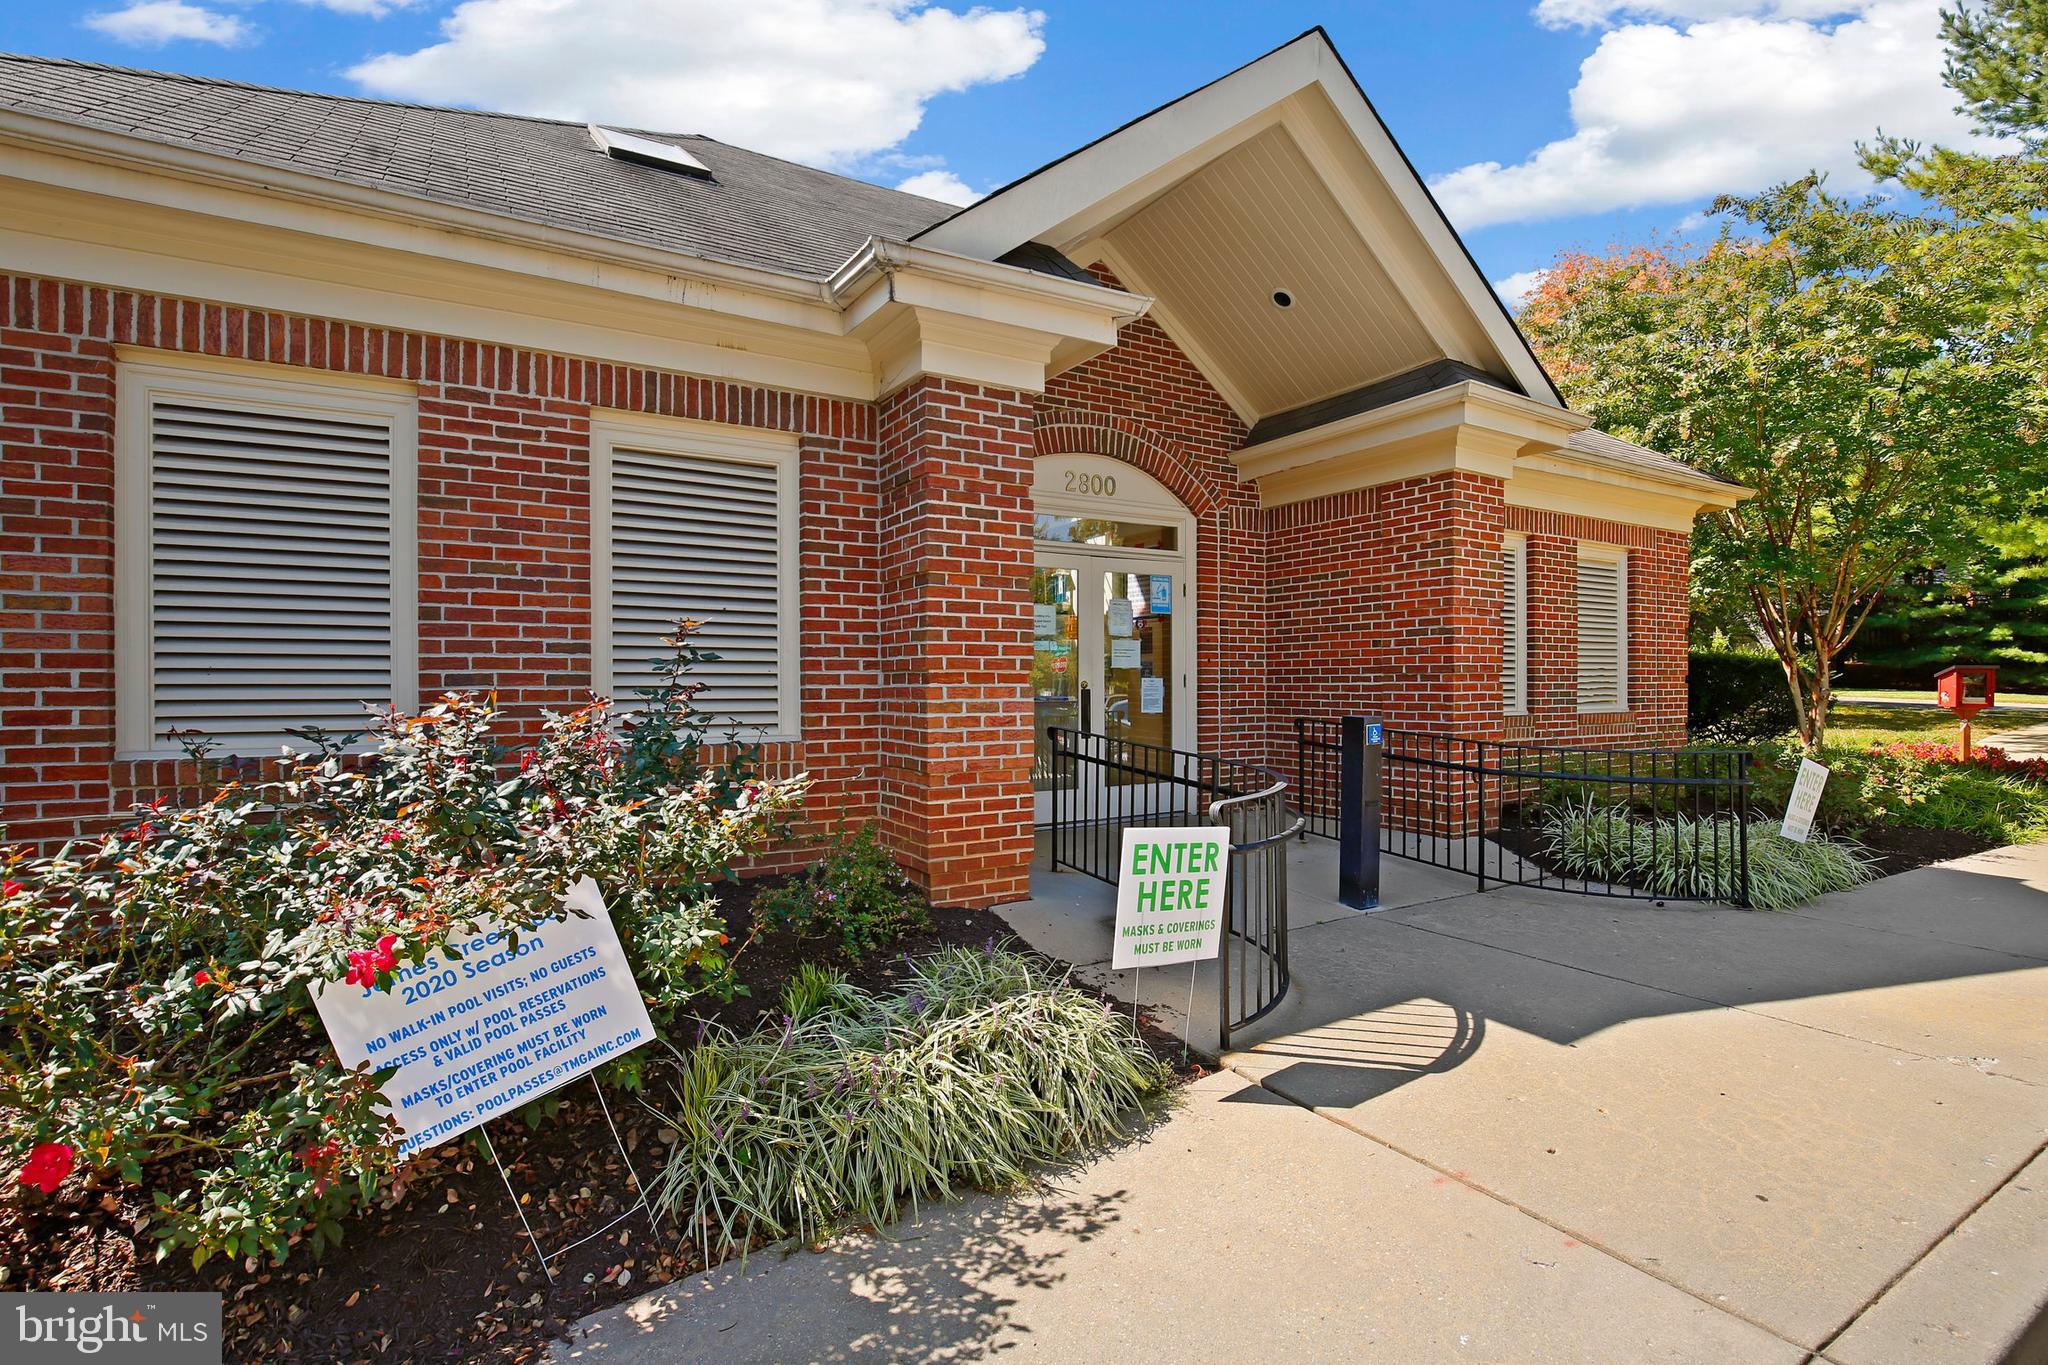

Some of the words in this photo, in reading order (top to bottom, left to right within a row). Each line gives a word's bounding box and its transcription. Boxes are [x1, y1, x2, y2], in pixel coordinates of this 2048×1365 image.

[1064, 470, 1116, 496] 2800
[1132, 842, 1220, 875] ENTER
[1122, 924, 1155, 937] MASKS
[1157, 923, 1164, 934] &
[1166, 919, 1216, 934] COVERINGS
[1137, 878, 1210, 912] HERE
[402, 970, 457, 1005] 2020
[462, 937, 544, 979] Season
[1134, 942, 1160, 955] MUST
[1162, 941, 1174, 952] BE
[1177, 938, 1202, 950] WORN
[365, 1037, 387, 1054] NO
[388, 1011, 446, 1043] WALK-IN
[447, 996, 483, 1018] POOL
[482, 977, 528, 1002] VISITS;
[529, 967, 548, 982] NO
[550, 946, 596, 973] GUESTS
[429, 1030, 461, 1052] ONLY
[465, 1020, 479, 1037] w/
[483, 1007, 517, 1028] POOL
[518, 966, 606, 1013] RESERVATIONS
[433, 1055, 444, 1067] &
[444, 1037, 482, 1061] VALID
[484, 1022, 518, 1043] POOL
[520, 999, 566, 1027] PASSES
[401, 1048, 515, 1108] MASKS/COVERING
[516, 1031, 551, 1054] MUST
[553, 1022, 570, 1037] BE
[571, 1005, 607, 1028] WORN
[435, 1093, 453, 1107] TO
[455, 1071, 498, 1099] ENTER
[499, 1056, 533, 1078] POOL
[534, 1029, 586, 1061] FACILITY
[476, 1027, 641, 1115] POOLPASSES@TMGAINC.COM
